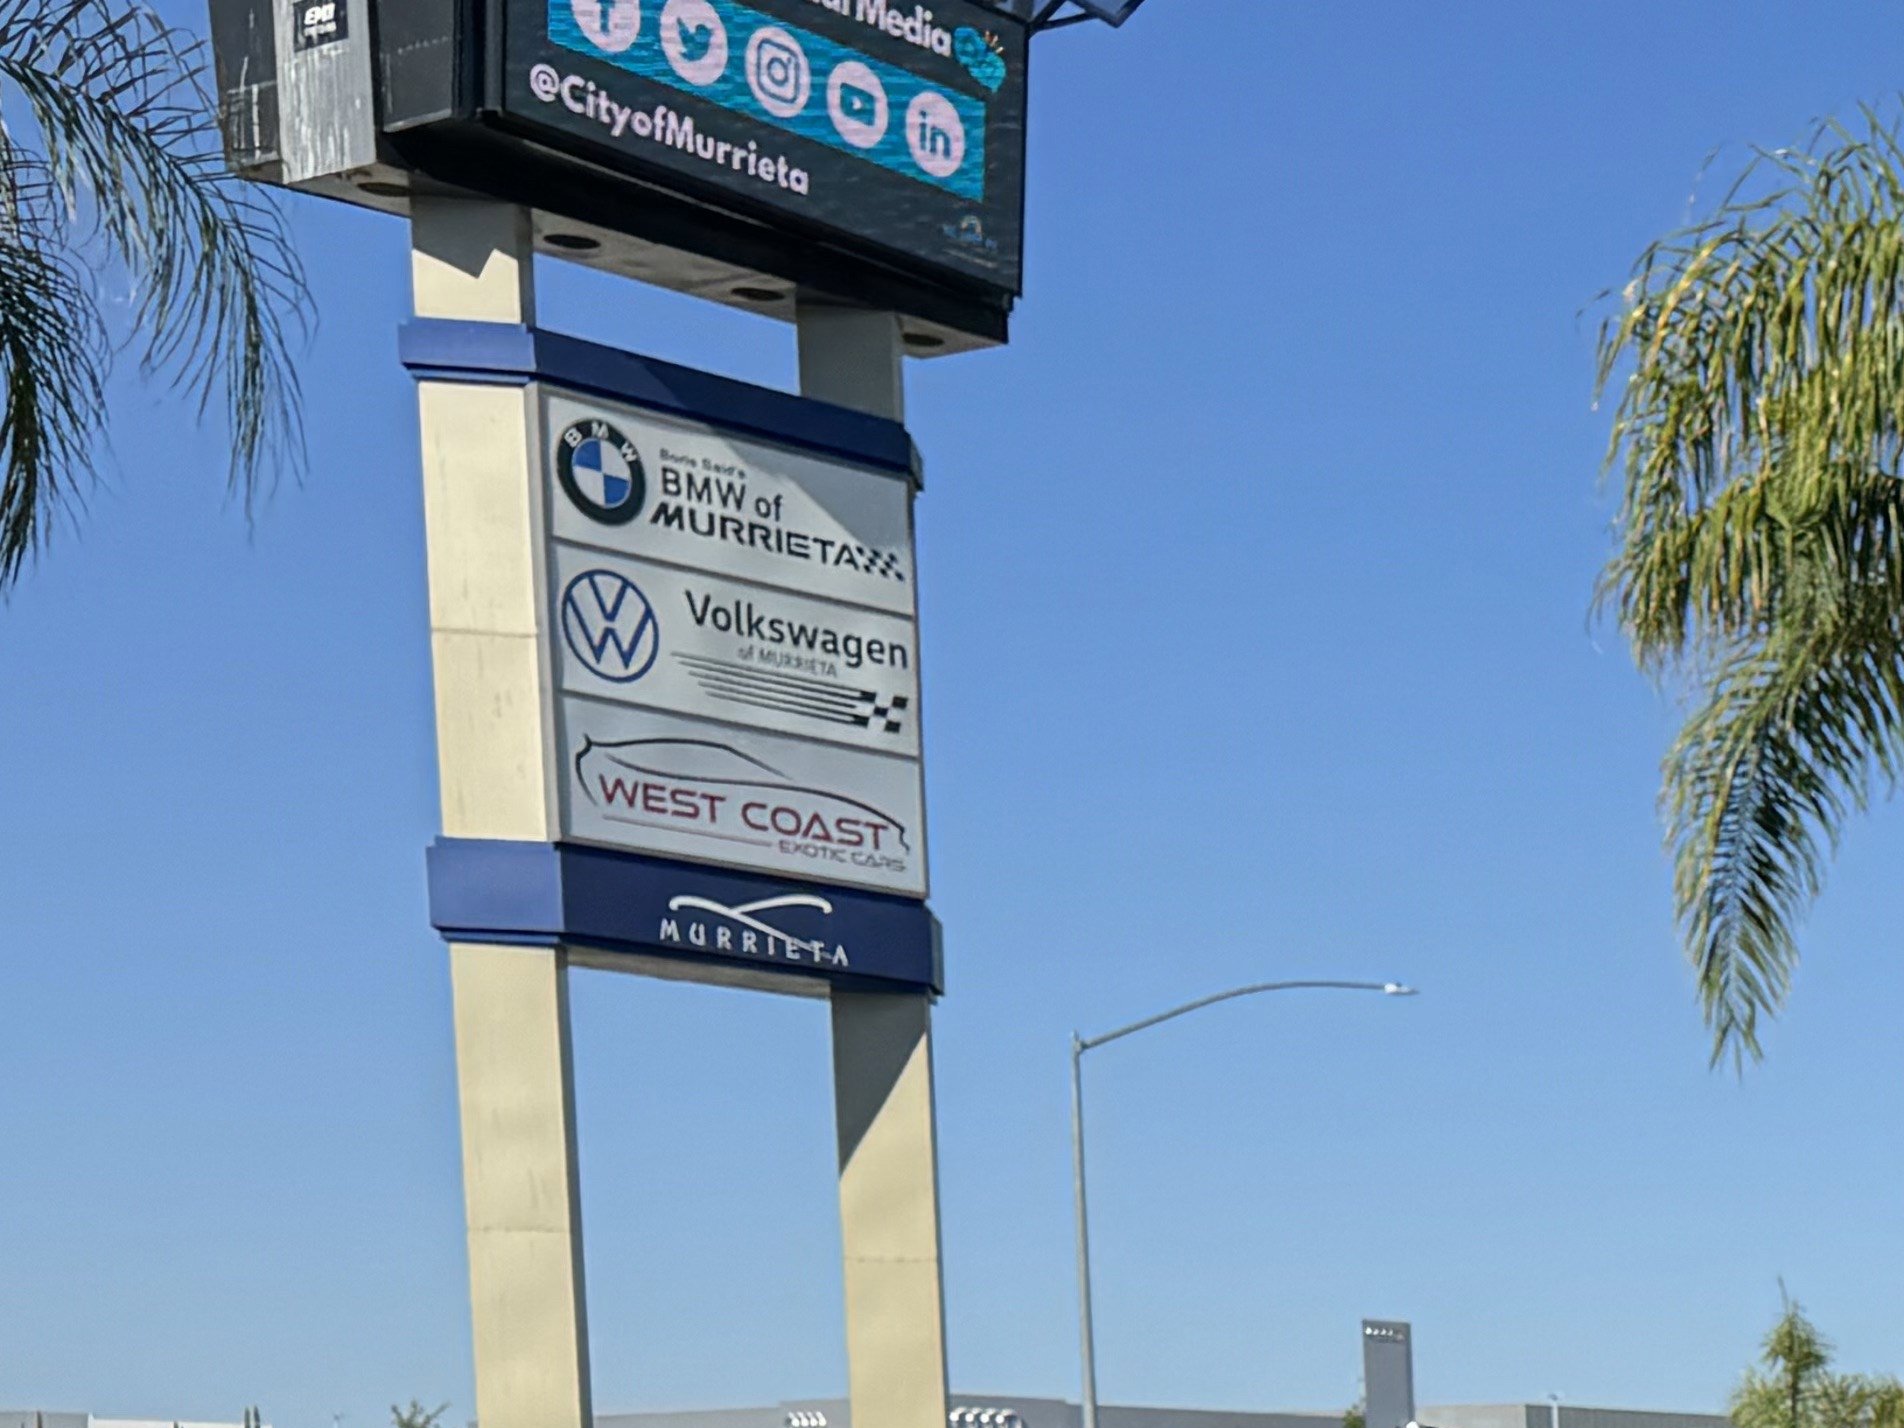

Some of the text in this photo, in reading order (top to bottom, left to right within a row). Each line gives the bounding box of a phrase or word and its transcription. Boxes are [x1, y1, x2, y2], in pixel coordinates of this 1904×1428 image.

[855, 0, 951, 57] Media
[529, 63, 809, 196] @CityofMurrieta
[661, 466, 783, 522] BMW of
[650, 502, 860, 571] MURRIETA
[685, 589, 908, 670] Volkswagen
[598, 773, 891, 850] WEST COAST
[779, 839, 906, 872] EXOTIC CARS
[659, 917, 849, 967] MURRIETA
